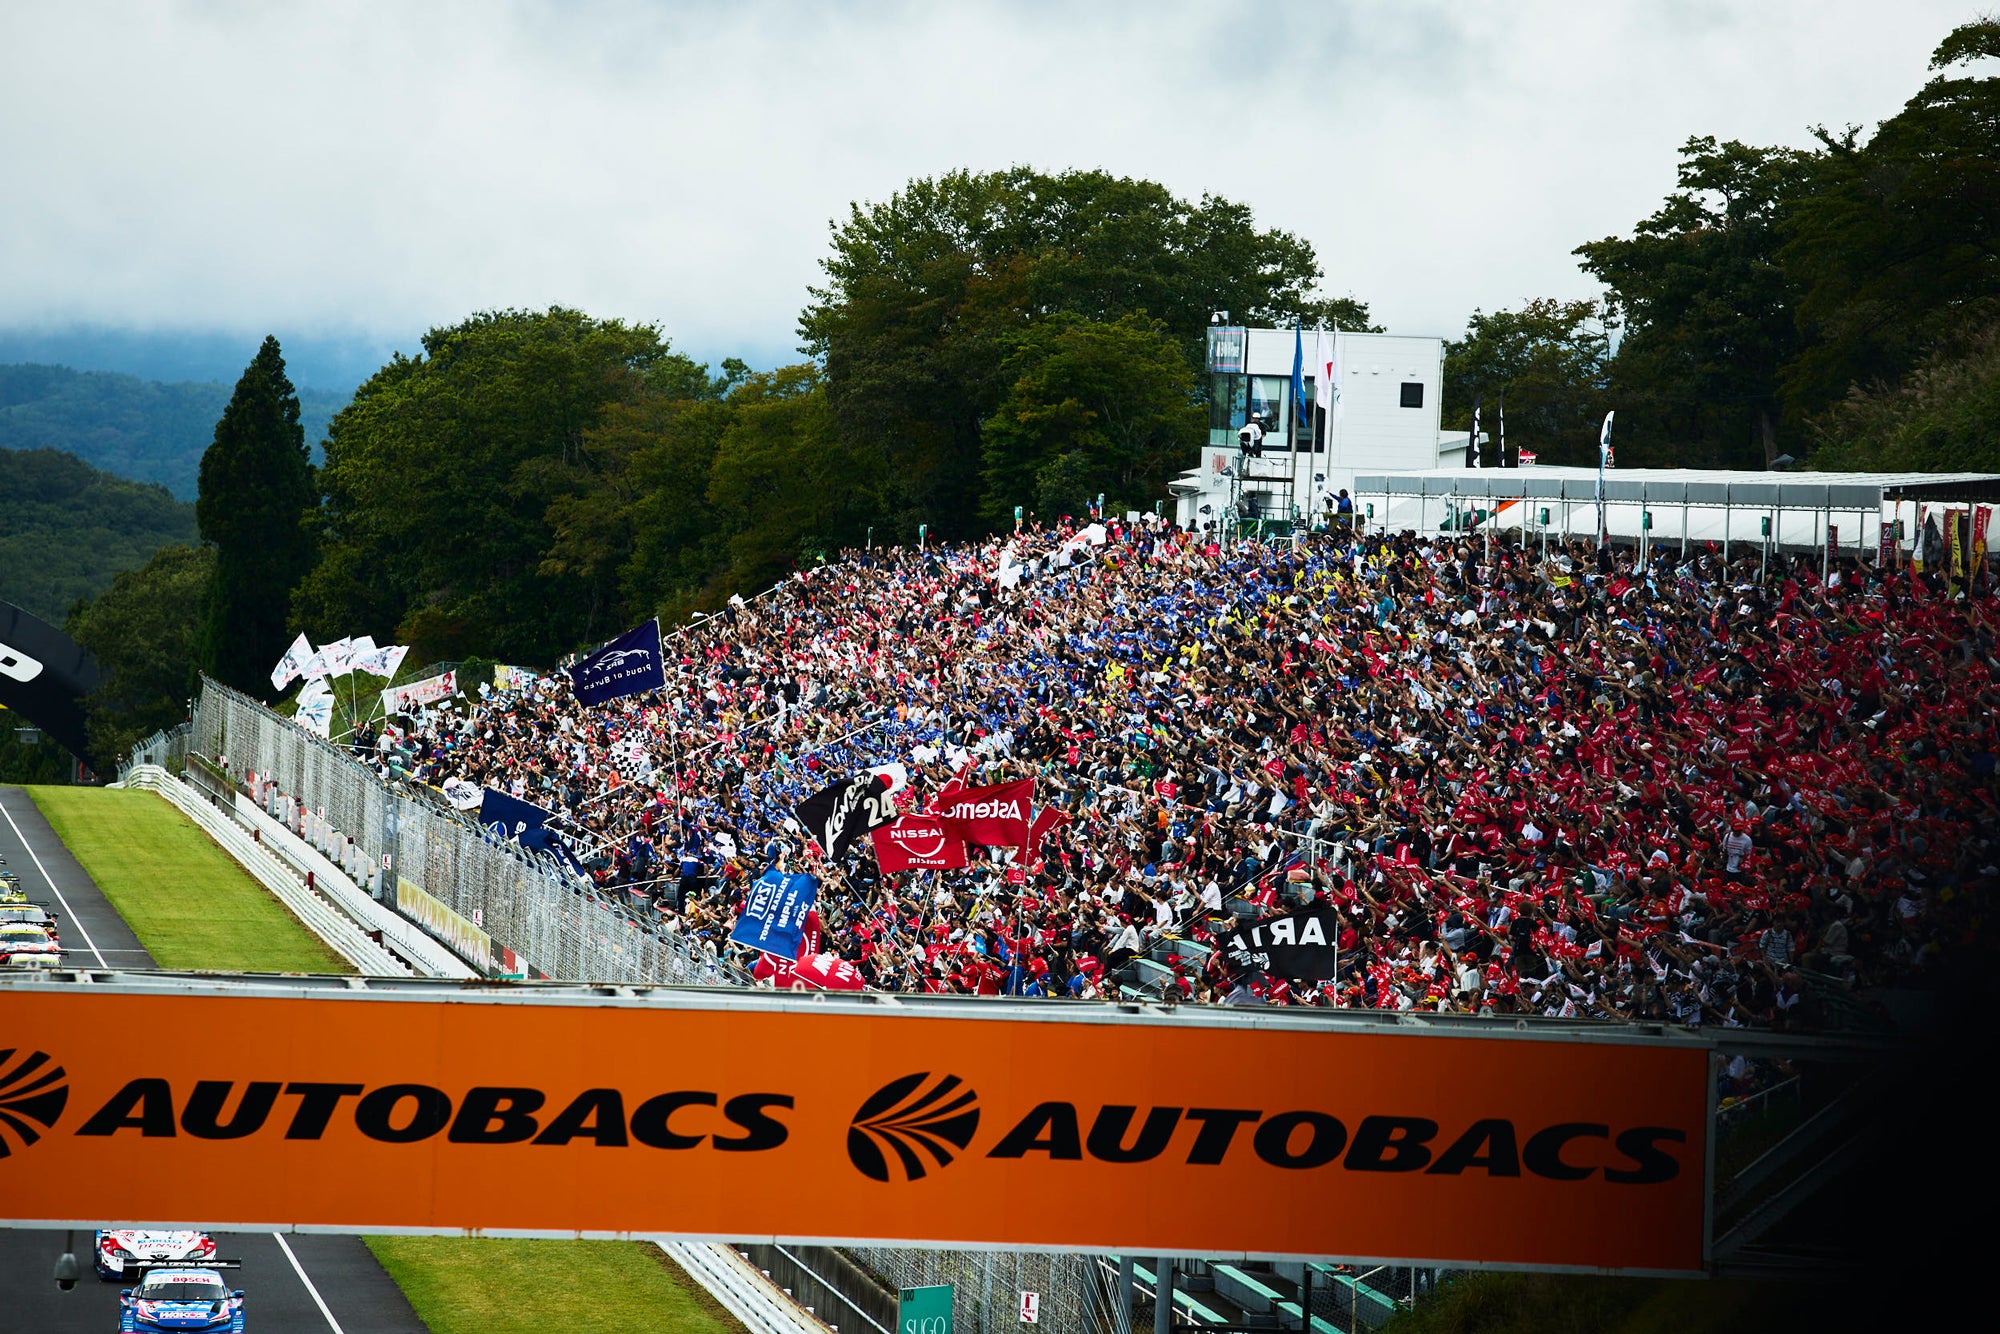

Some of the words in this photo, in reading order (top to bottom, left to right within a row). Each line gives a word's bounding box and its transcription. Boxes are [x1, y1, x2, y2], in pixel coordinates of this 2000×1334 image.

[863, 789, 898, 828] 24
[750, 885, 772, 913] TRS
[777, 890, 799, 928] IMPUL
[760, 914, 775, 941] TOKYO
[74, 1078, 795, 1152] AUTOBACS
[985, 1101, 1686, 1185] AUTOBACS
